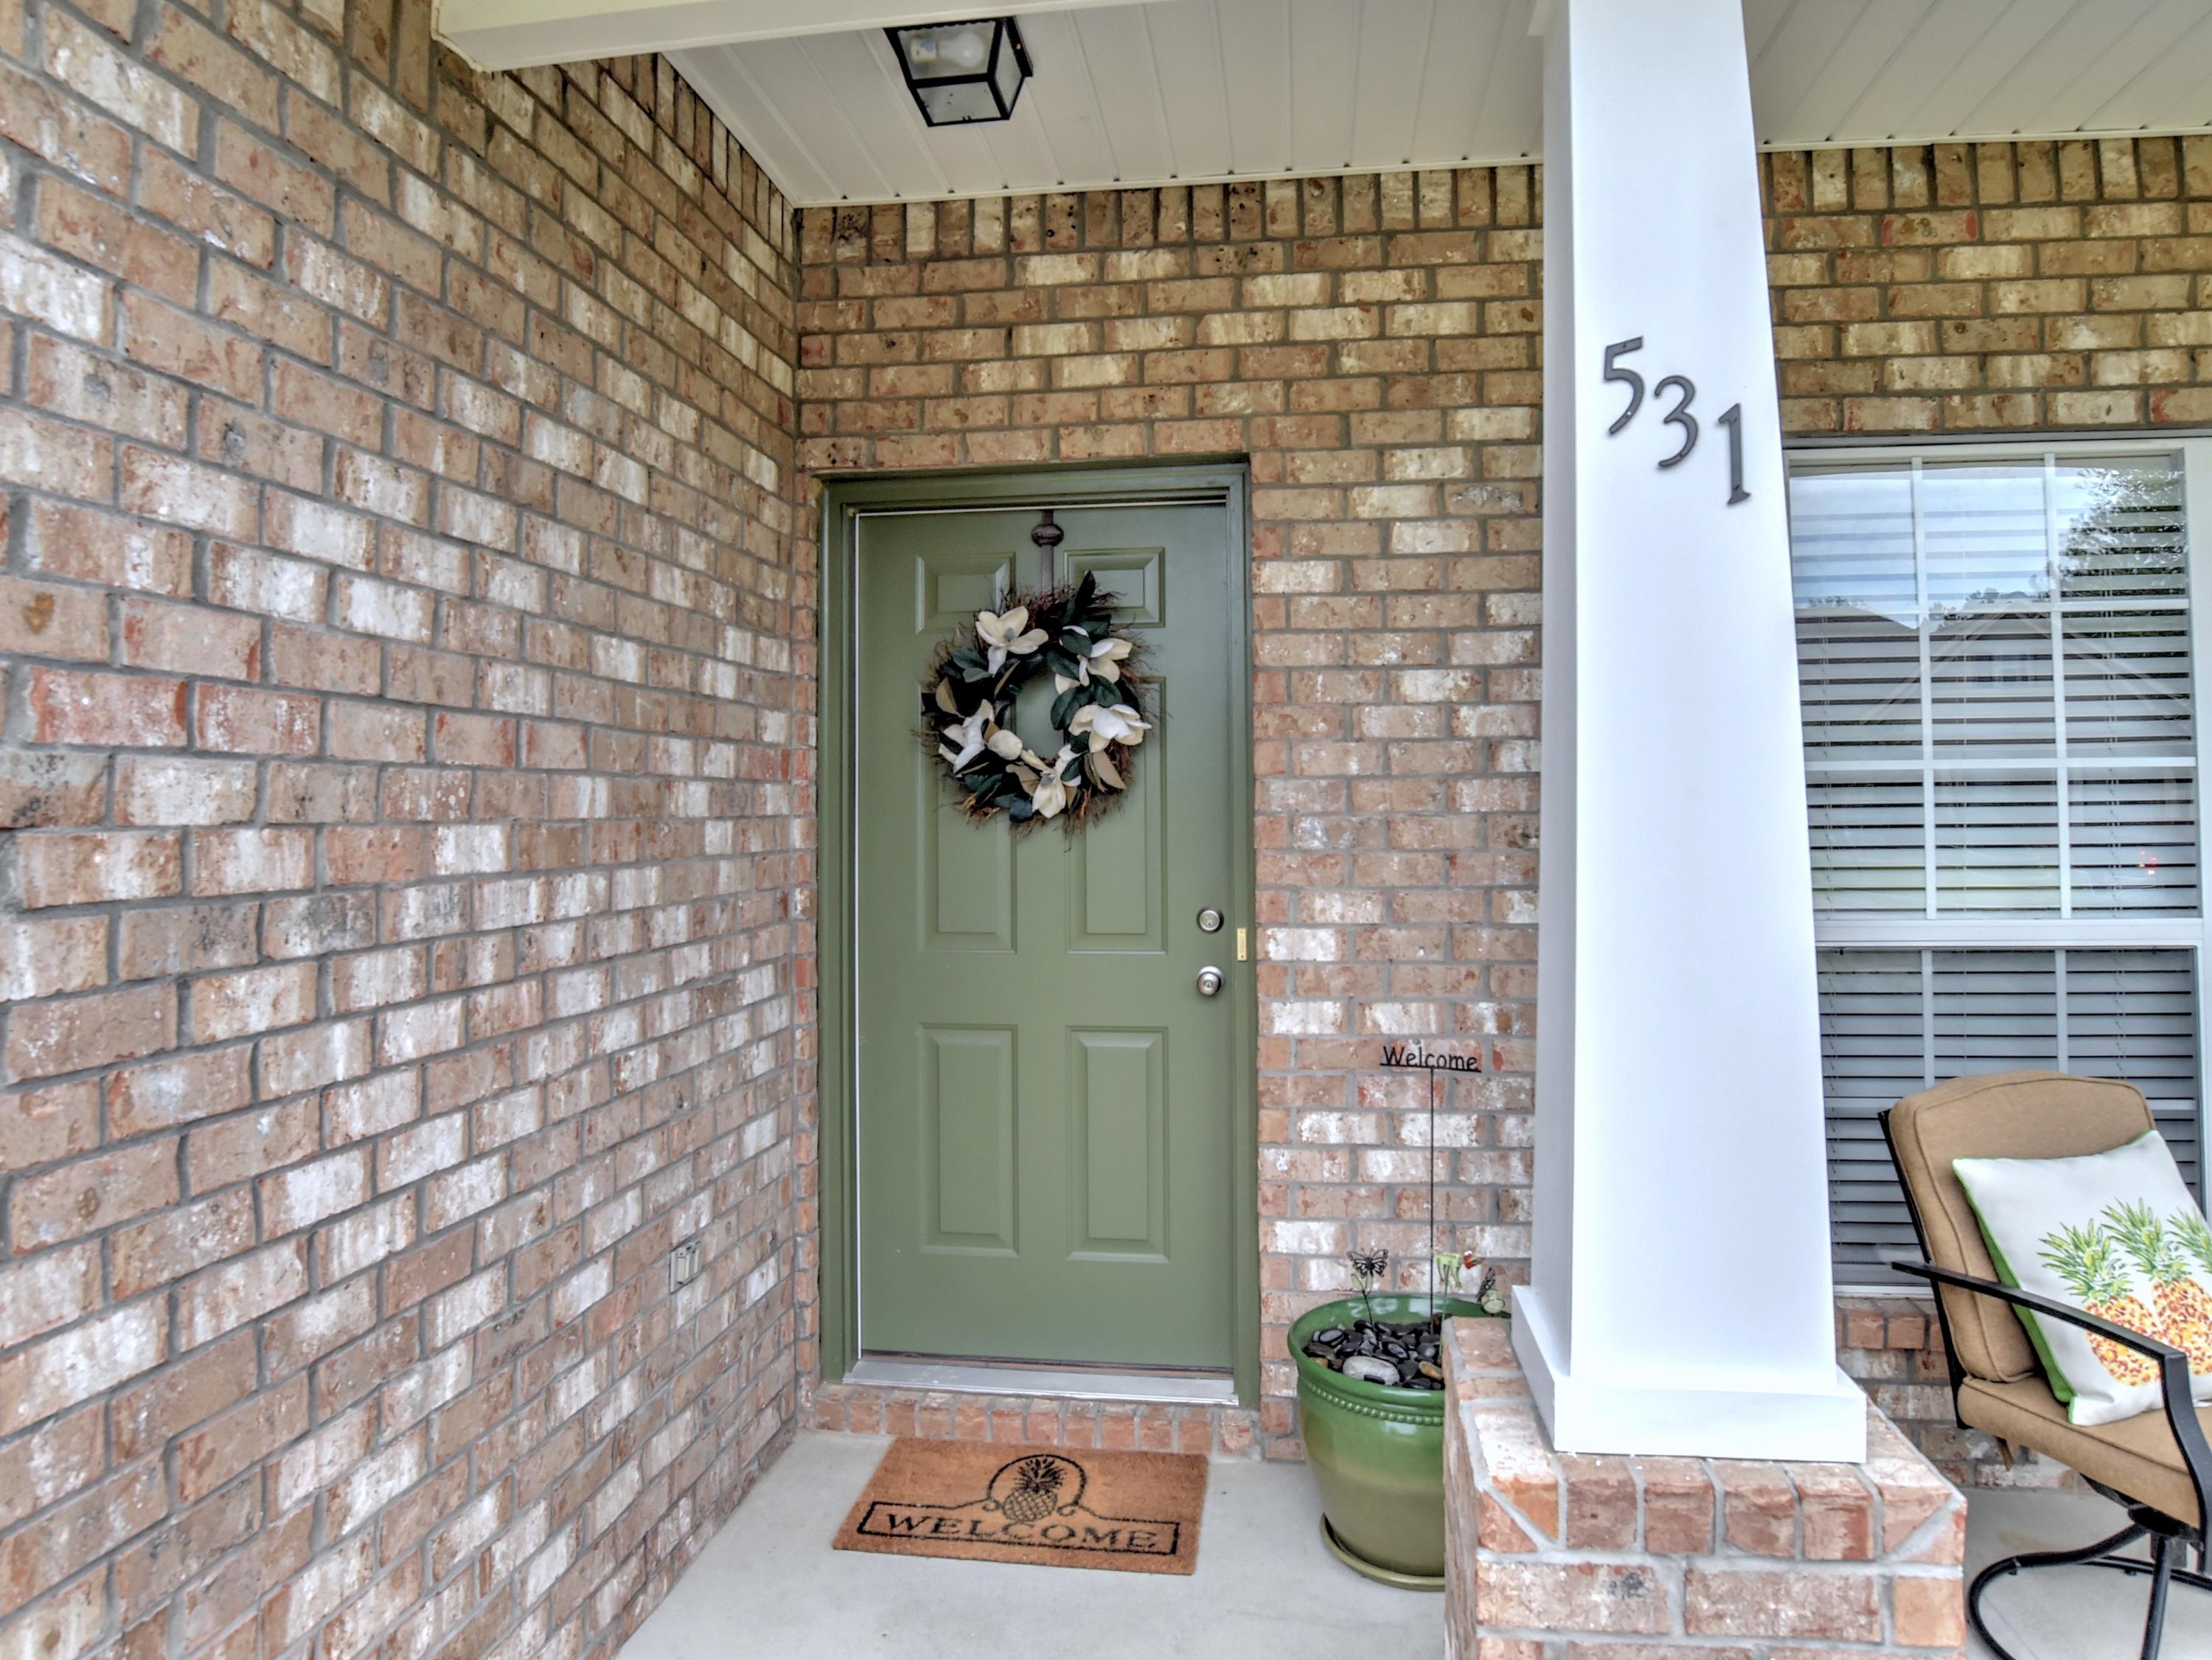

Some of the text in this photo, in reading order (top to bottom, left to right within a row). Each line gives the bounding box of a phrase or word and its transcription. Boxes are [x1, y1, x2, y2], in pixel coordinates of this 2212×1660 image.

[1603, 336, 1751, 506] 531
[1383, 1046, 1478, 1072] Welcome
[886, 1512, 1157, 1549] WELCOME
